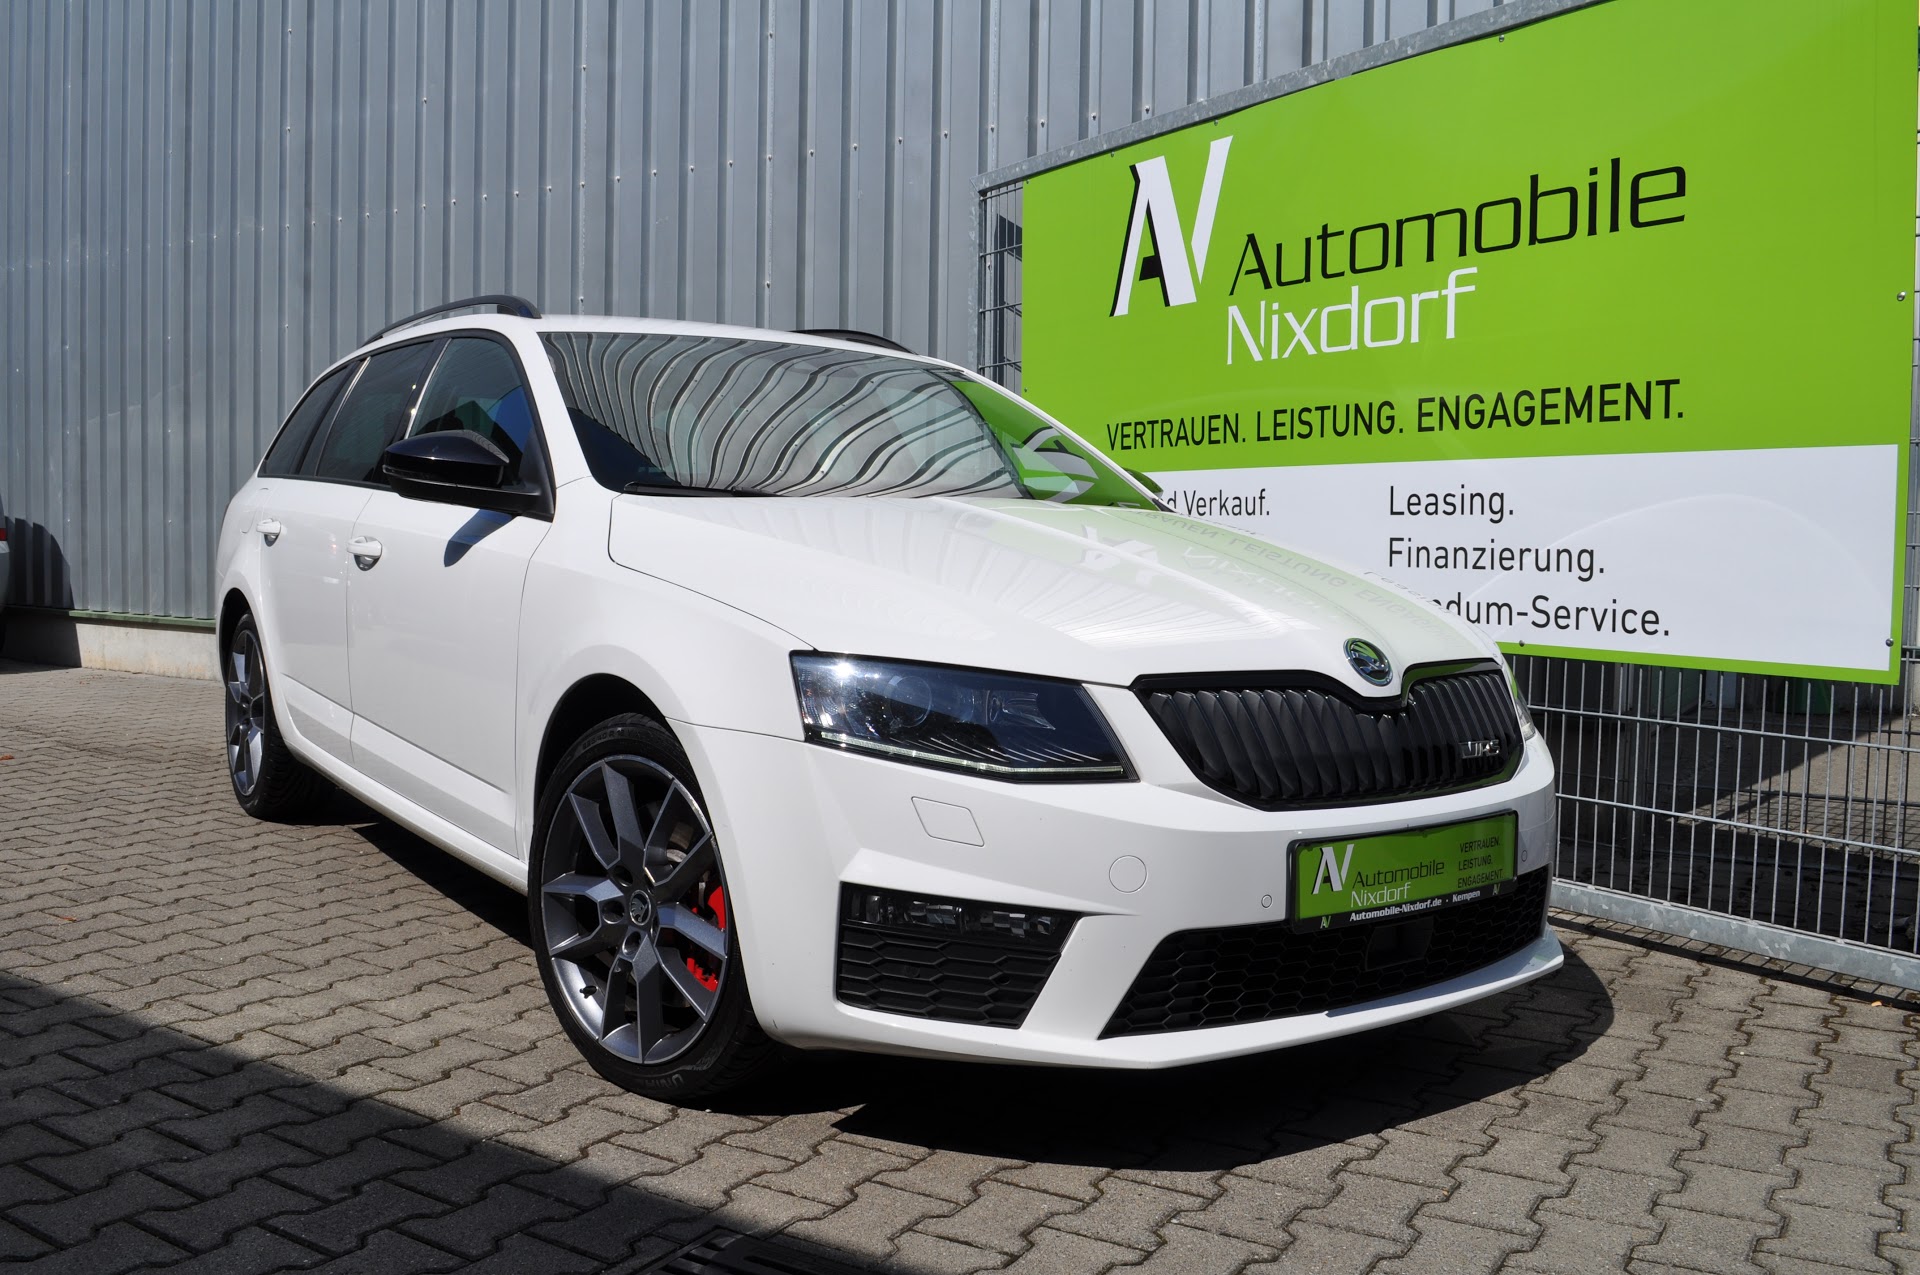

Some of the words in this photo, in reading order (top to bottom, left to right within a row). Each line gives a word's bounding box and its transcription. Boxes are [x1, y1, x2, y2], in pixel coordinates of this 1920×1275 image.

[1228, 157, 1687, 297] Automobile
[1227, 266, 1478, 365] Nixdorf
[1106, 412, 1246, 451] VERTRAUEN.
[1256, 400, 1404, 442] LEISTUNG.
[1417, 378, 1684, 433] ENGAGEMENT.
[1183, 488, 1270, 517] Verkauf.
[1389, 483, 1514, 525] Leasing.
[1388, 537, 1605, 583] Finanzierung.
[1431, 591, 1670, 637] dum-Service.
[1350, 881, 1412, 908] Nixdorf
[1352, 859, 1445, 889] Automobile
[1349, 898, 1442, 922] Automobile-Nixdorf.de
[1452, 890, 1481, 902] Kempen
